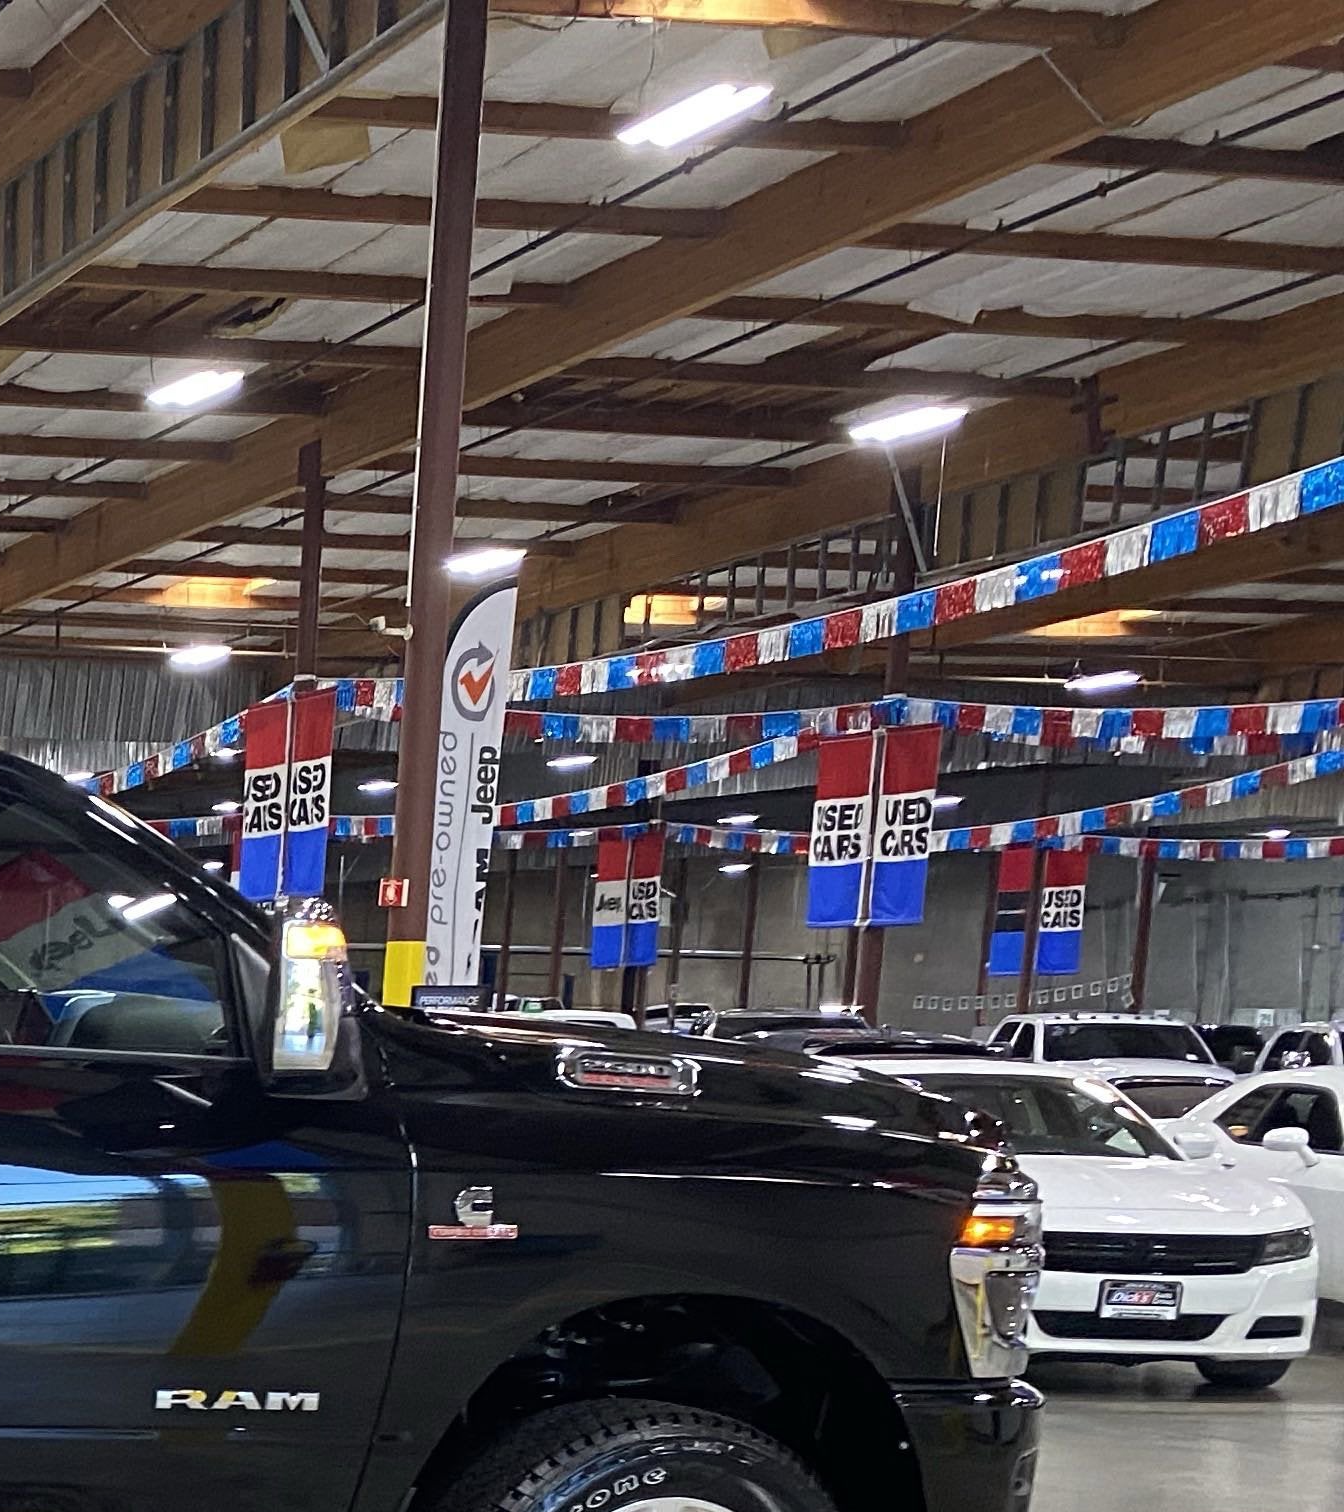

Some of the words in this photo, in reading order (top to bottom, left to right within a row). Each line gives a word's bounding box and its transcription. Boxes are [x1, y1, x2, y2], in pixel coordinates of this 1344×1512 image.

[471, 745, 500, 824] Jeep
[430, 730, 458, 925] pre-owned
[155, 1390, 320, 1411] RAM
